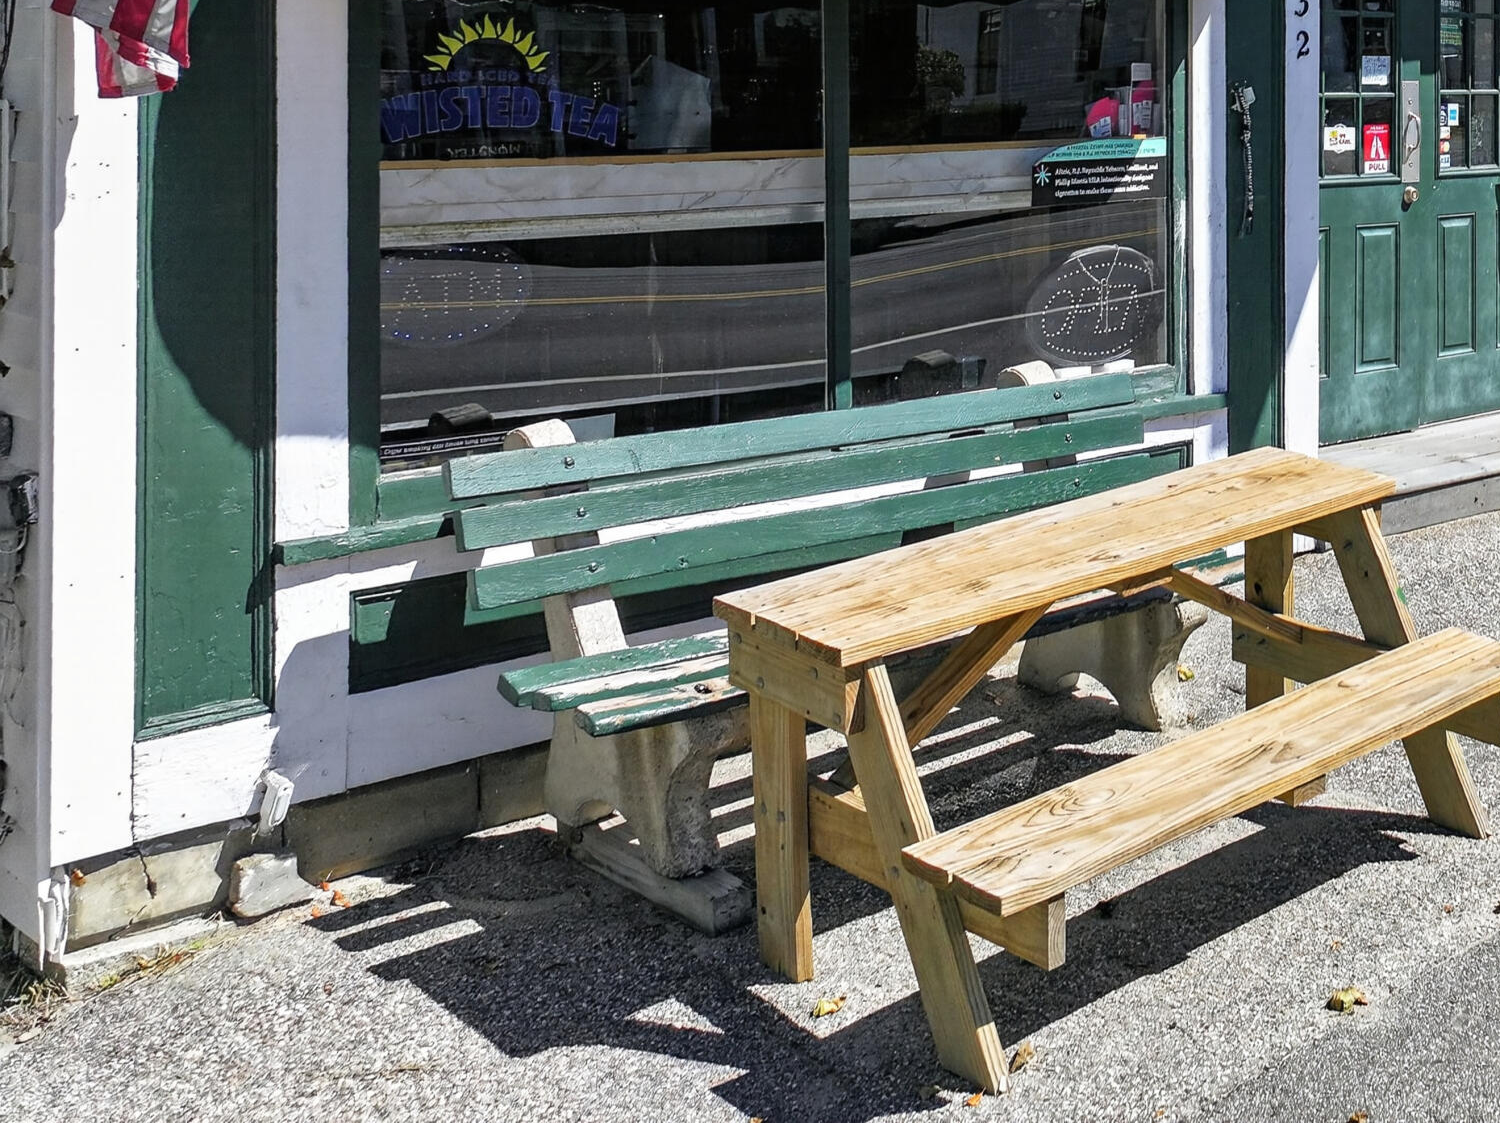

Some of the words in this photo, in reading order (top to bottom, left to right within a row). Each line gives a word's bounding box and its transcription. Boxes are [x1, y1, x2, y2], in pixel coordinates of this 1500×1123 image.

[380, 85, 541, 143] WISTED
[549, 89, 620, 147] TEA
[1368, 163, 1386, 171] PULL
[394, 268, 503, 325] ATM
